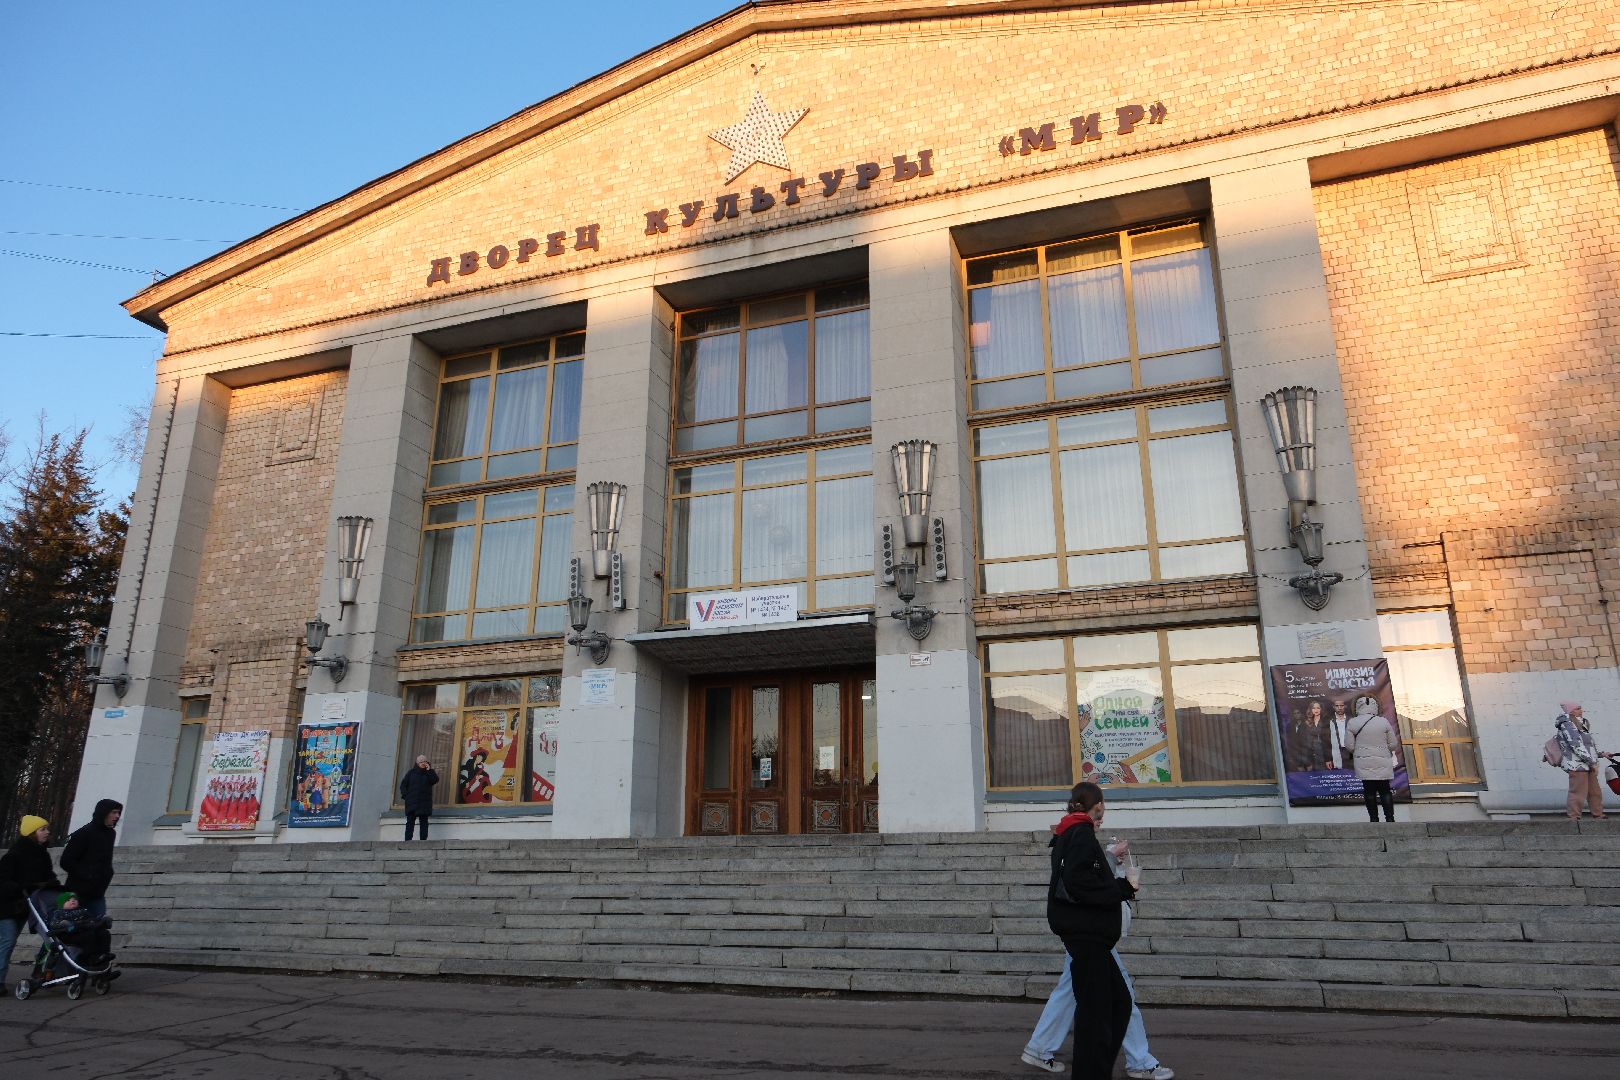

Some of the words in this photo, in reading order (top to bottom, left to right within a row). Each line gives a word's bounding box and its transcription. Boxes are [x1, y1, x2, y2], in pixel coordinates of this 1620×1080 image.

[426, 223, 600, 287] ДВОРЕЦ
[644, 149, 934, 236] КУЛЬТУРЫ
[998, 101, 1167, 157] «МИР»
[1285, 670, 1295, 683] 5
[1324, 666, 1375, 680] ИЛЛЮЗИЯ
[1327, 677, 1376, 689] СЧАСТЬЯ
